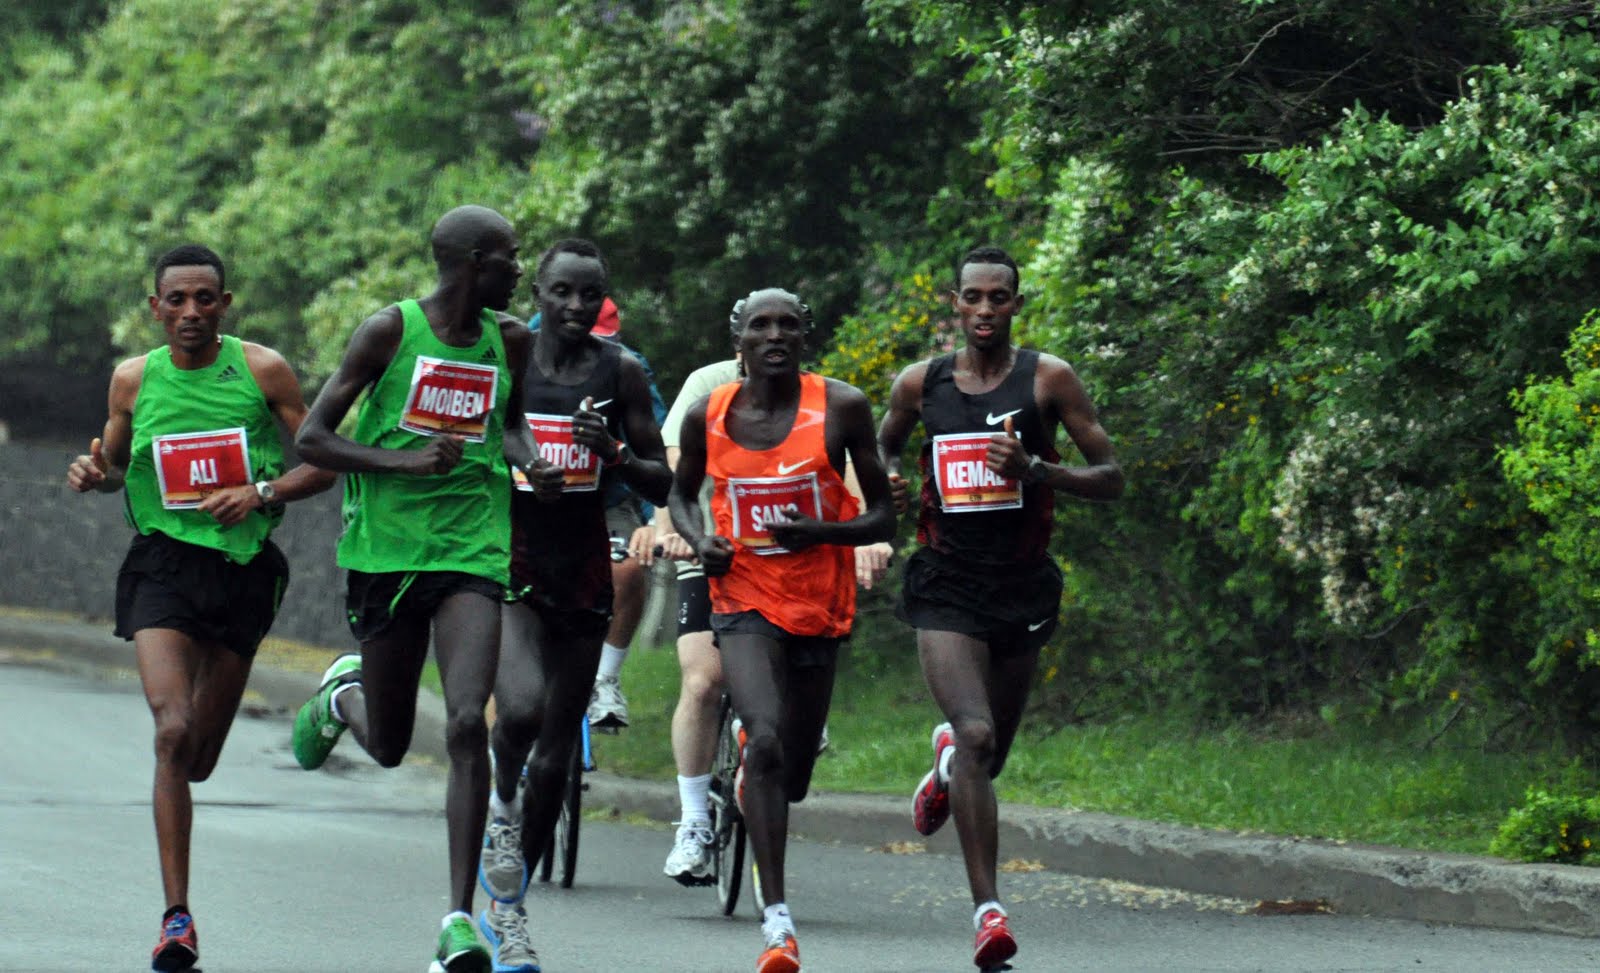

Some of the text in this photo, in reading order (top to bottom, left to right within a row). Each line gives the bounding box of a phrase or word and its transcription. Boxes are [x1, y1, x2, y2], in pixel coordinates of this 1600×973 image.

[417, 385, 485, 419] MOIBEN
[536, 442, 591, 470] OTICH
[189, 458, 219, 486] ALI
